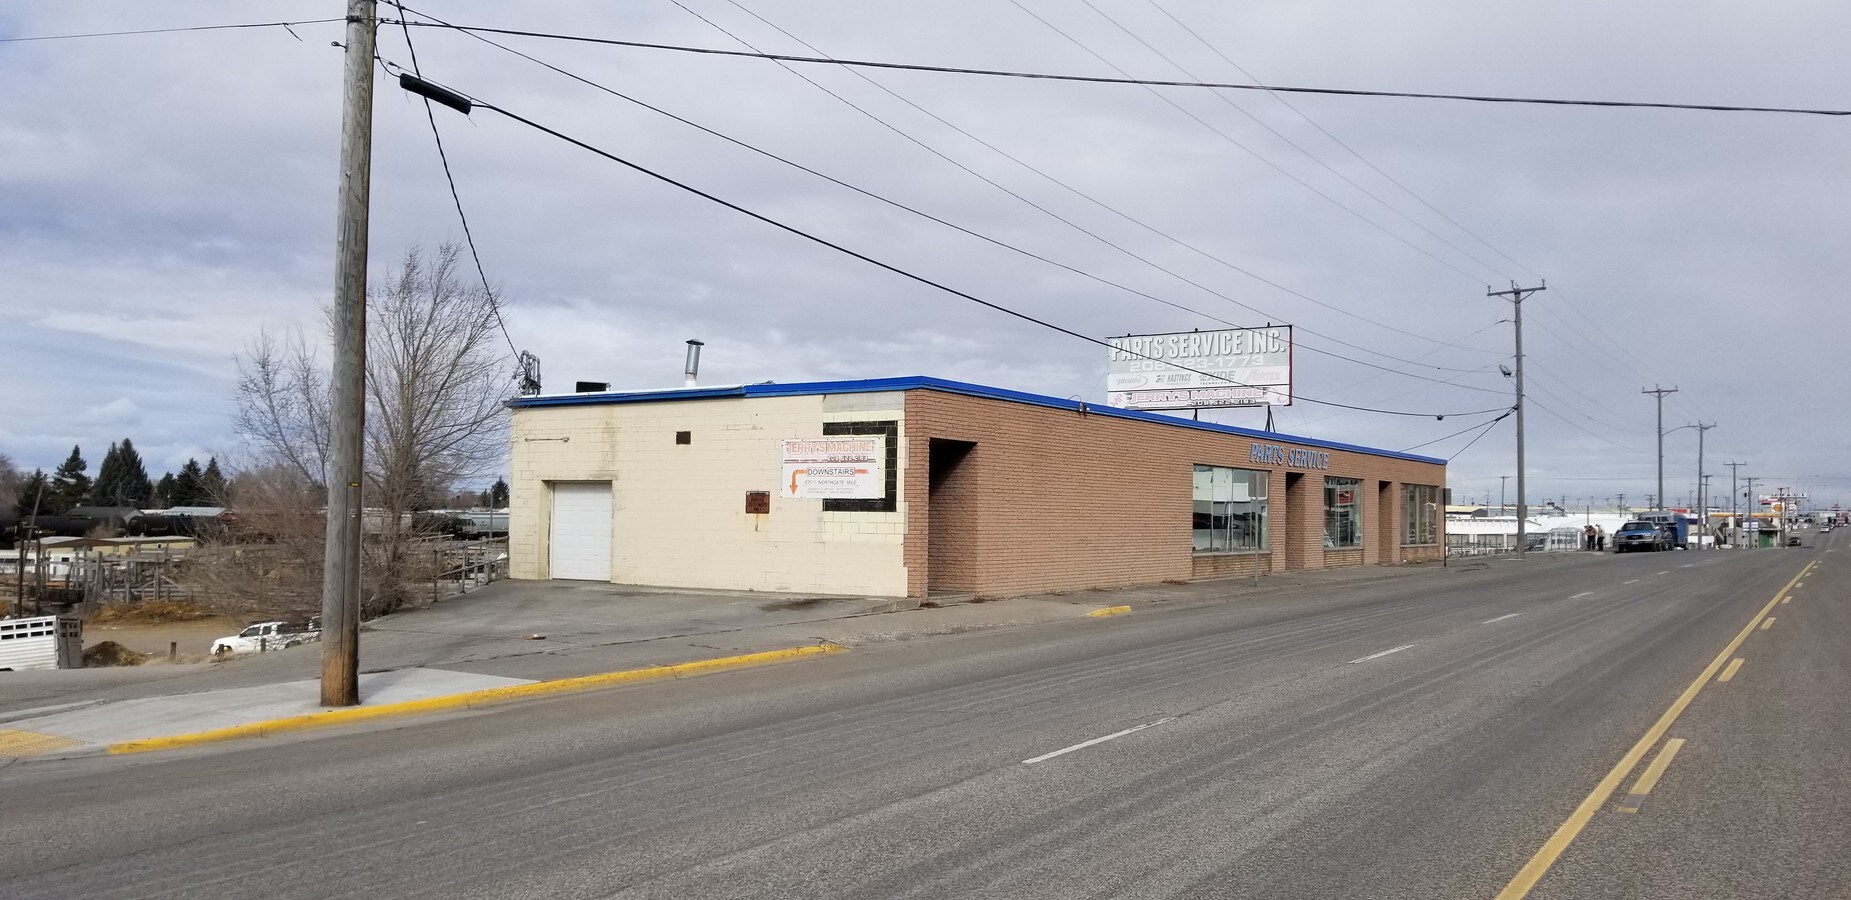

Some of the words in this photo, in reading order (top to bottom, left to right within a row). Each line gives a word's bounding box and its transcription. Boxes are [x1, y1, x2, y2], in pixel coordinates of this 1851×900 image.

[1112, 336, 1164, 361] PARTS
[1168, 331, 1243, 359] SERVICE
[1248, 328, 1287, 354] INC.
[1166, 373, 1192, 383] HASTINGS
[1130, 390, 1190, 404] JERRY'S
[1190, 387, 1264, 401] MACHINE
[788, 442, 827, 454] JERRY'S
[827, 441, 872, 453] MACHINE
[1249, 443, 1286, 465] PARTS
[1287, 448, 1329, 470] SERVICE
[808, 468, 854, 476] DOWNSTAIRS
